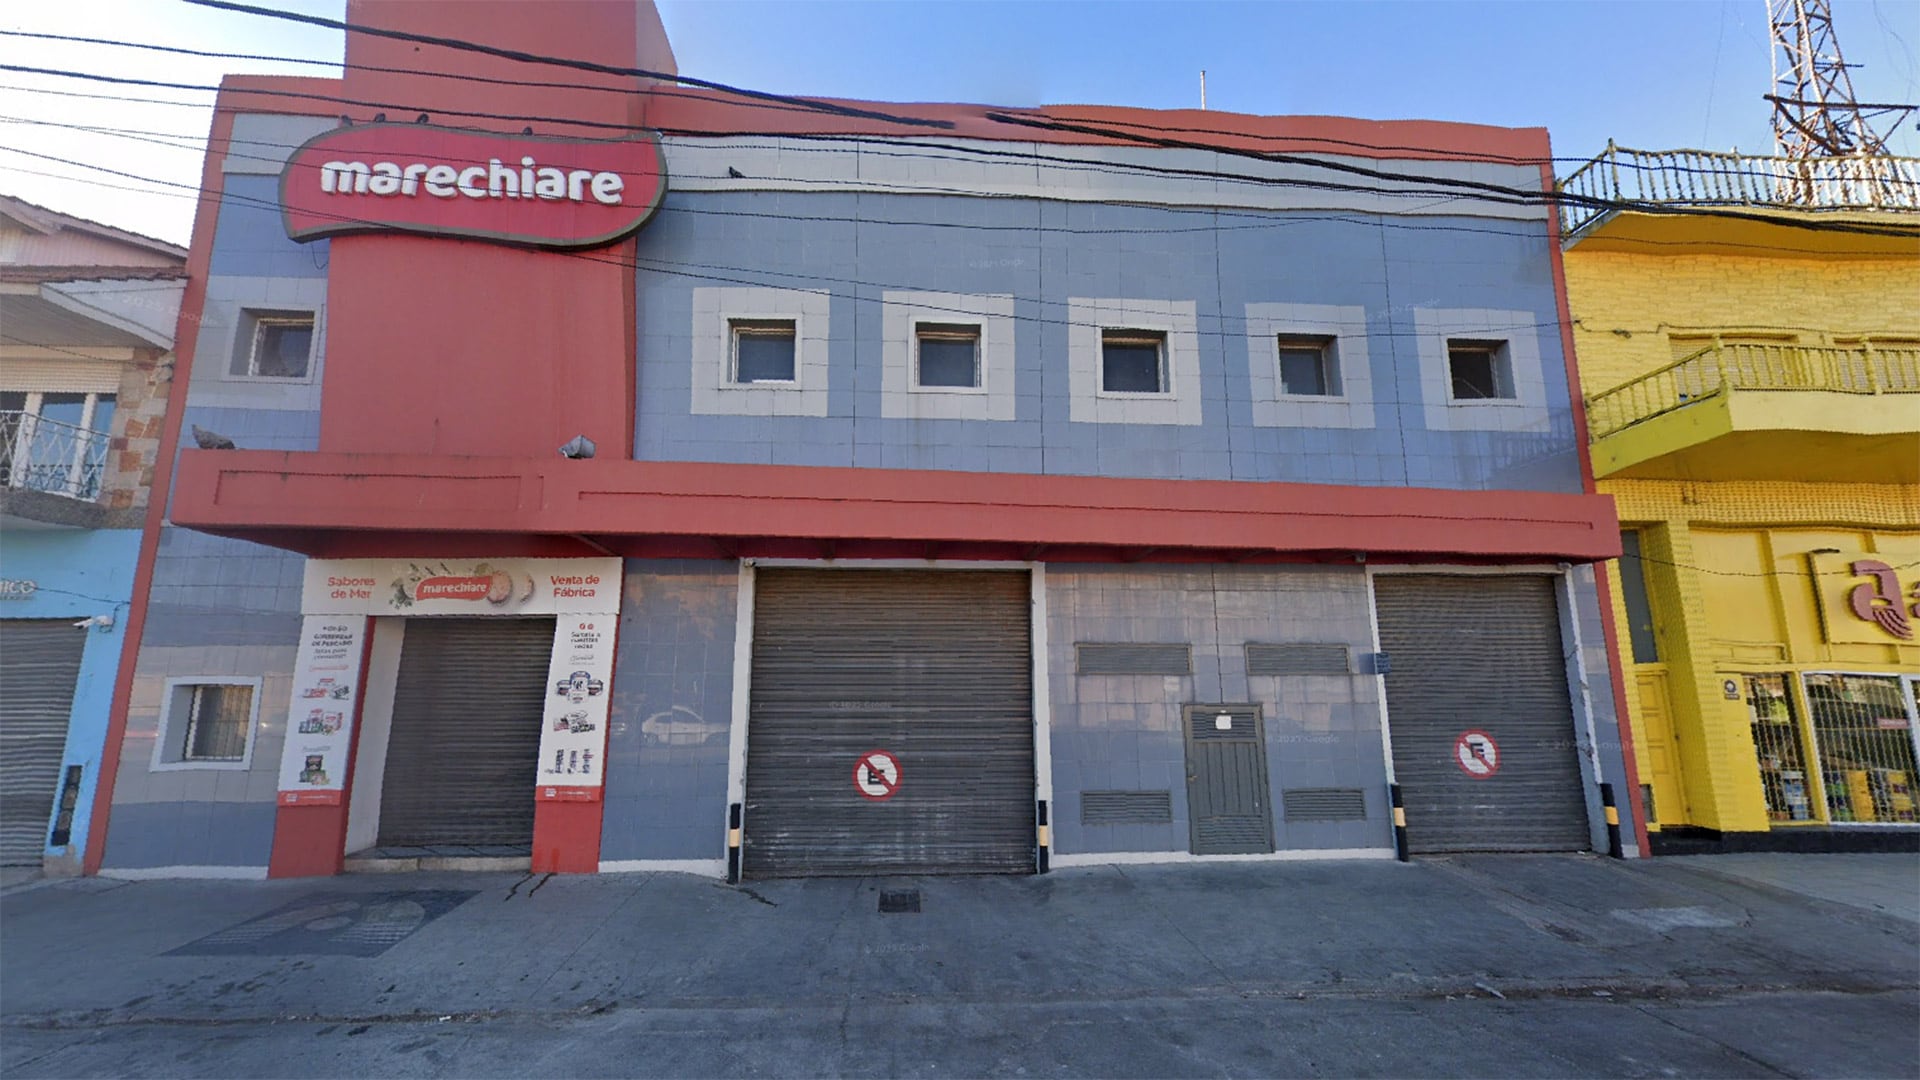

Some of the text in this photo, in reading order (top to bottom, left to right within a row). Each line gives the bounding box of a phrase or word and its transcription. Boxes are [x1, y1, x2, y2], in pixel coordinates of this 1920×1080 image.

[320, 156, 624, 204] marechiare
[328, 576, 376, 586] Sabores
[550, 574, 600, 585] Venta de
[423, 581, 487, 594] marechiare
[553, 587, 595, 598] Fábrica
[331, 589, 371, 599] de Mar
